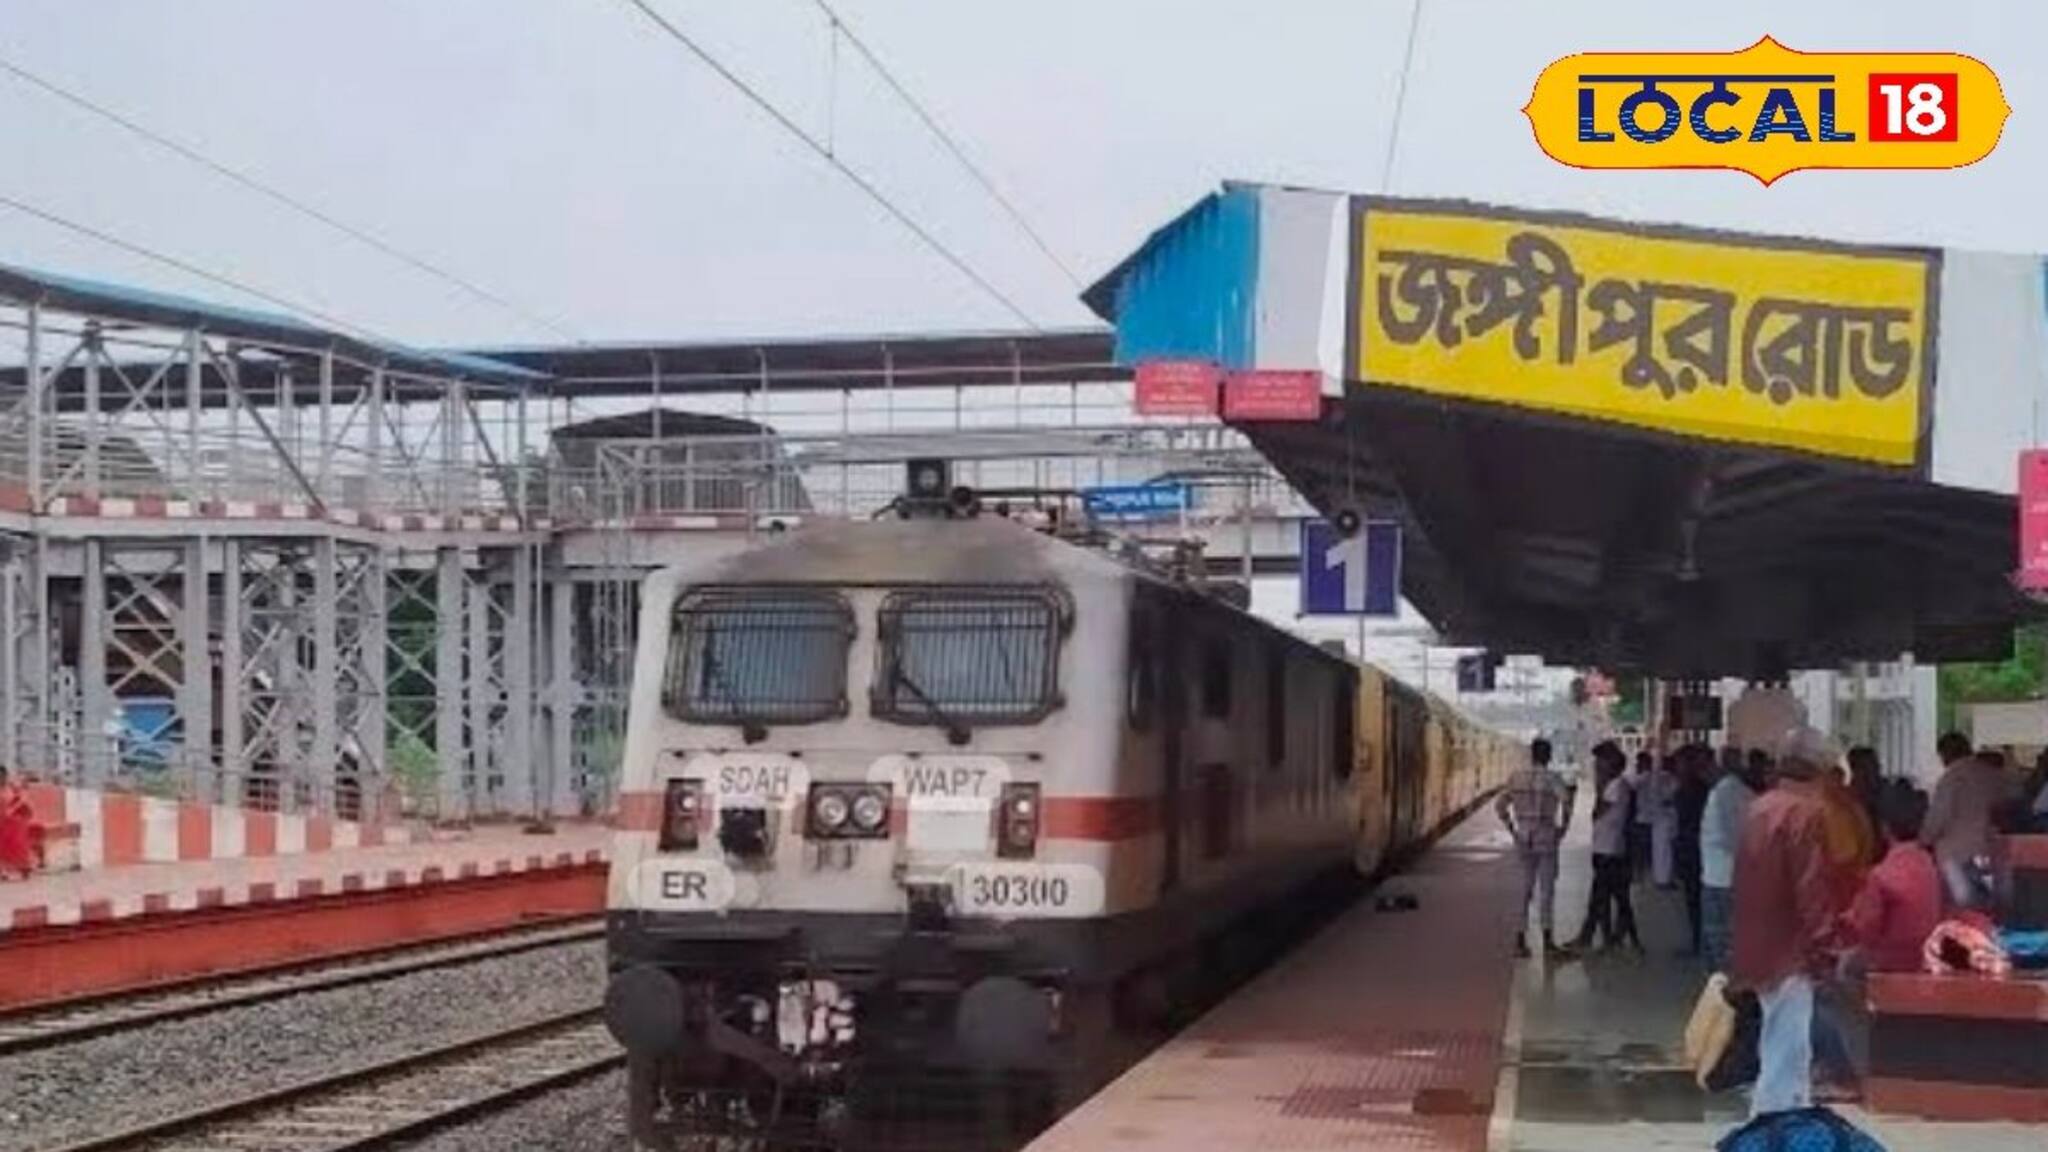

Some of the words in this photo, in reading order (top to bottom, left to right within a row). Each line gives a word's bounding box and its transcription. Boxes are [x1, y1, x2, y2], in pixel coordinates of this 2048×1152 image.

[1377, 231, 1739, 400] জঙ্গীপুর
[1741, 296, 1914, 405] রোড
[1325, 523, 1369, 611] 1
[719, 766, 790, 794] SDAH
[903, 765, 988, 798] WAP7
[662, 870, 707, 899] ER
[973, 874, 1069, 907] 30300
